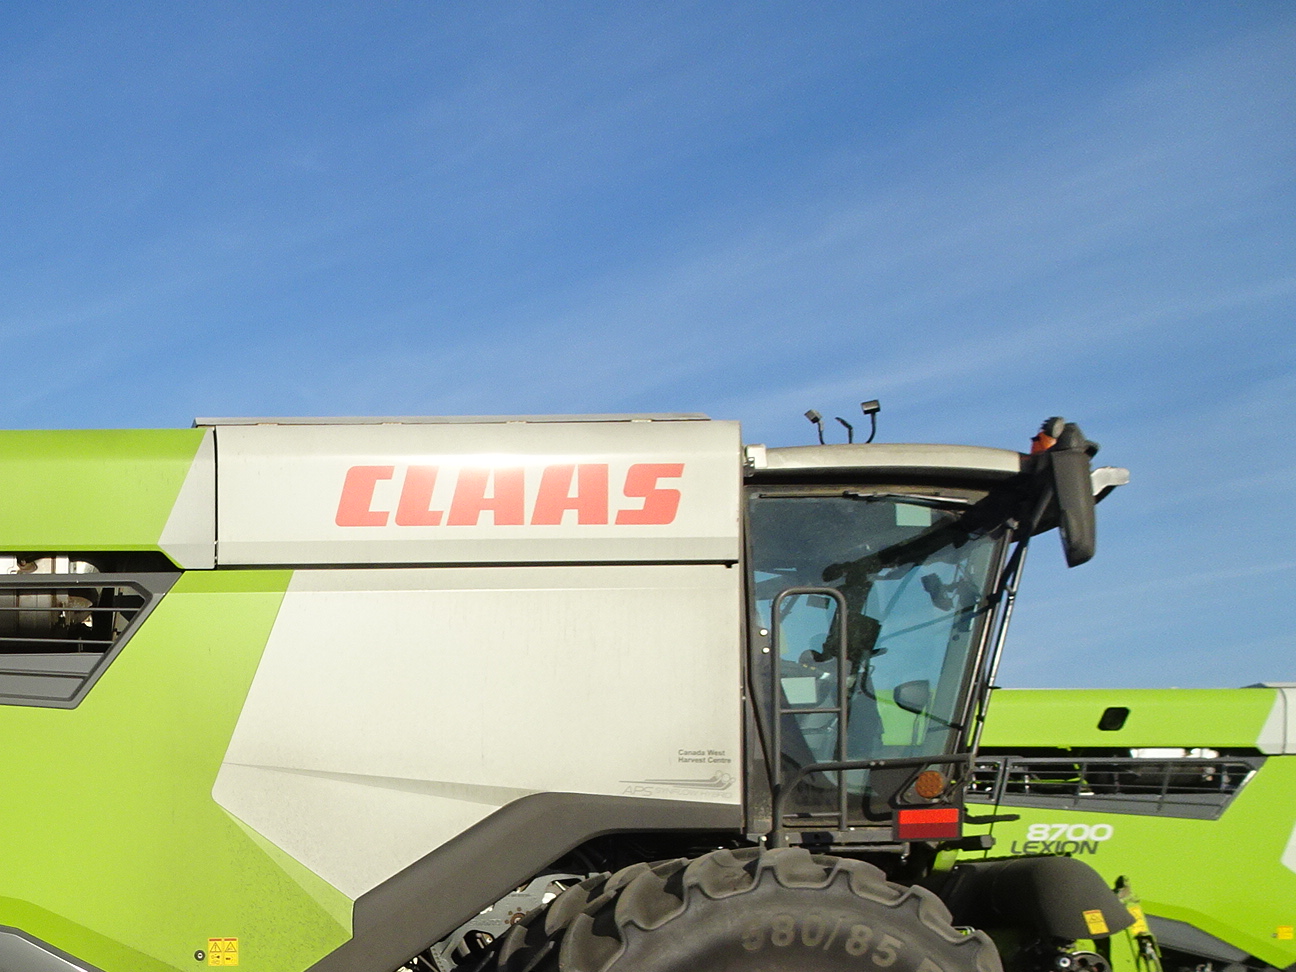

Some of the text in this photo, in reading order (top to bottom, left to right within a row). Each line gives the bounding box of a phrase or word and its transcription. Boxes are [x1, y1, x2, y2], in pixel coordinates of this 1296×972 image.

[335, 463, 685, 527] CLAAS
[623, 785, 653, 796] APS
[1026, 823, 1114, 841] 8700
[1010, 841, 1099, 855] LEXION
